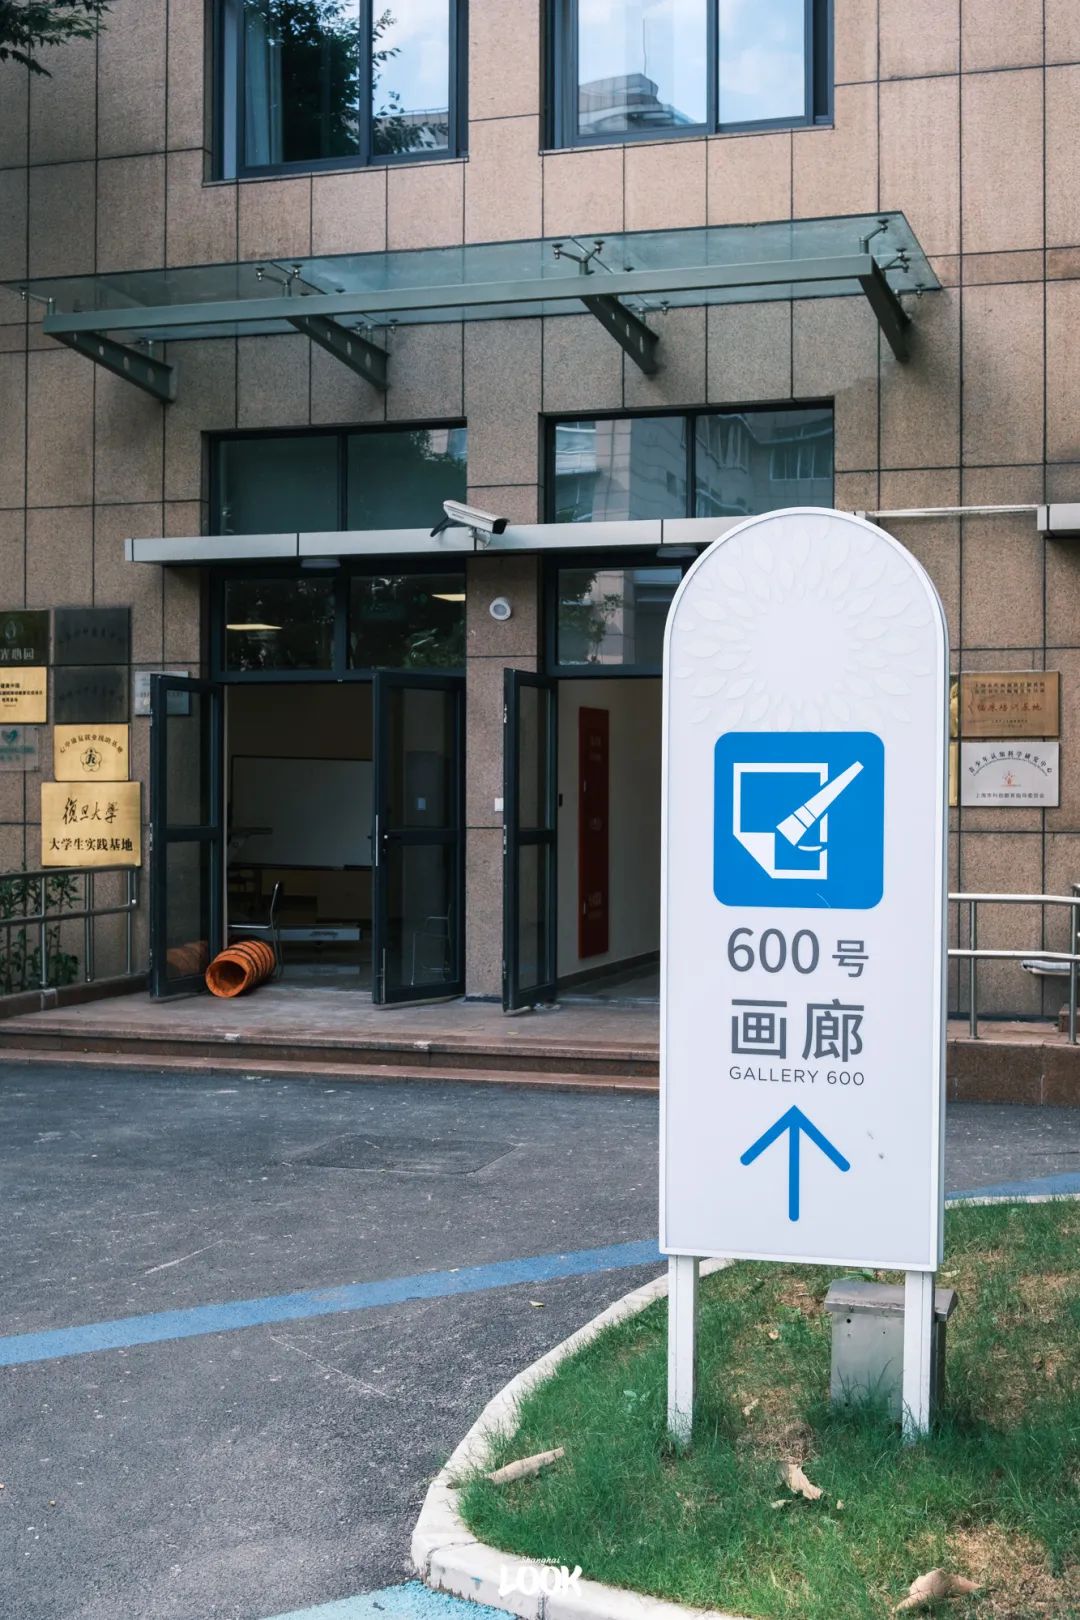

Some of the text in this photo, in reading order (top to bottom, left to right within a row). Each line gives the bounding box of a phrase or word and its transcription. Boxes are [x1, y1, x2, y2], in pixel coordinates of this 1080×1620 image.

[49, 837, 133, 851] 大学生实践基地
[731, 998, 865, 1063] 画廊
[729, 1066, 865, 1086] GALLERY 600
